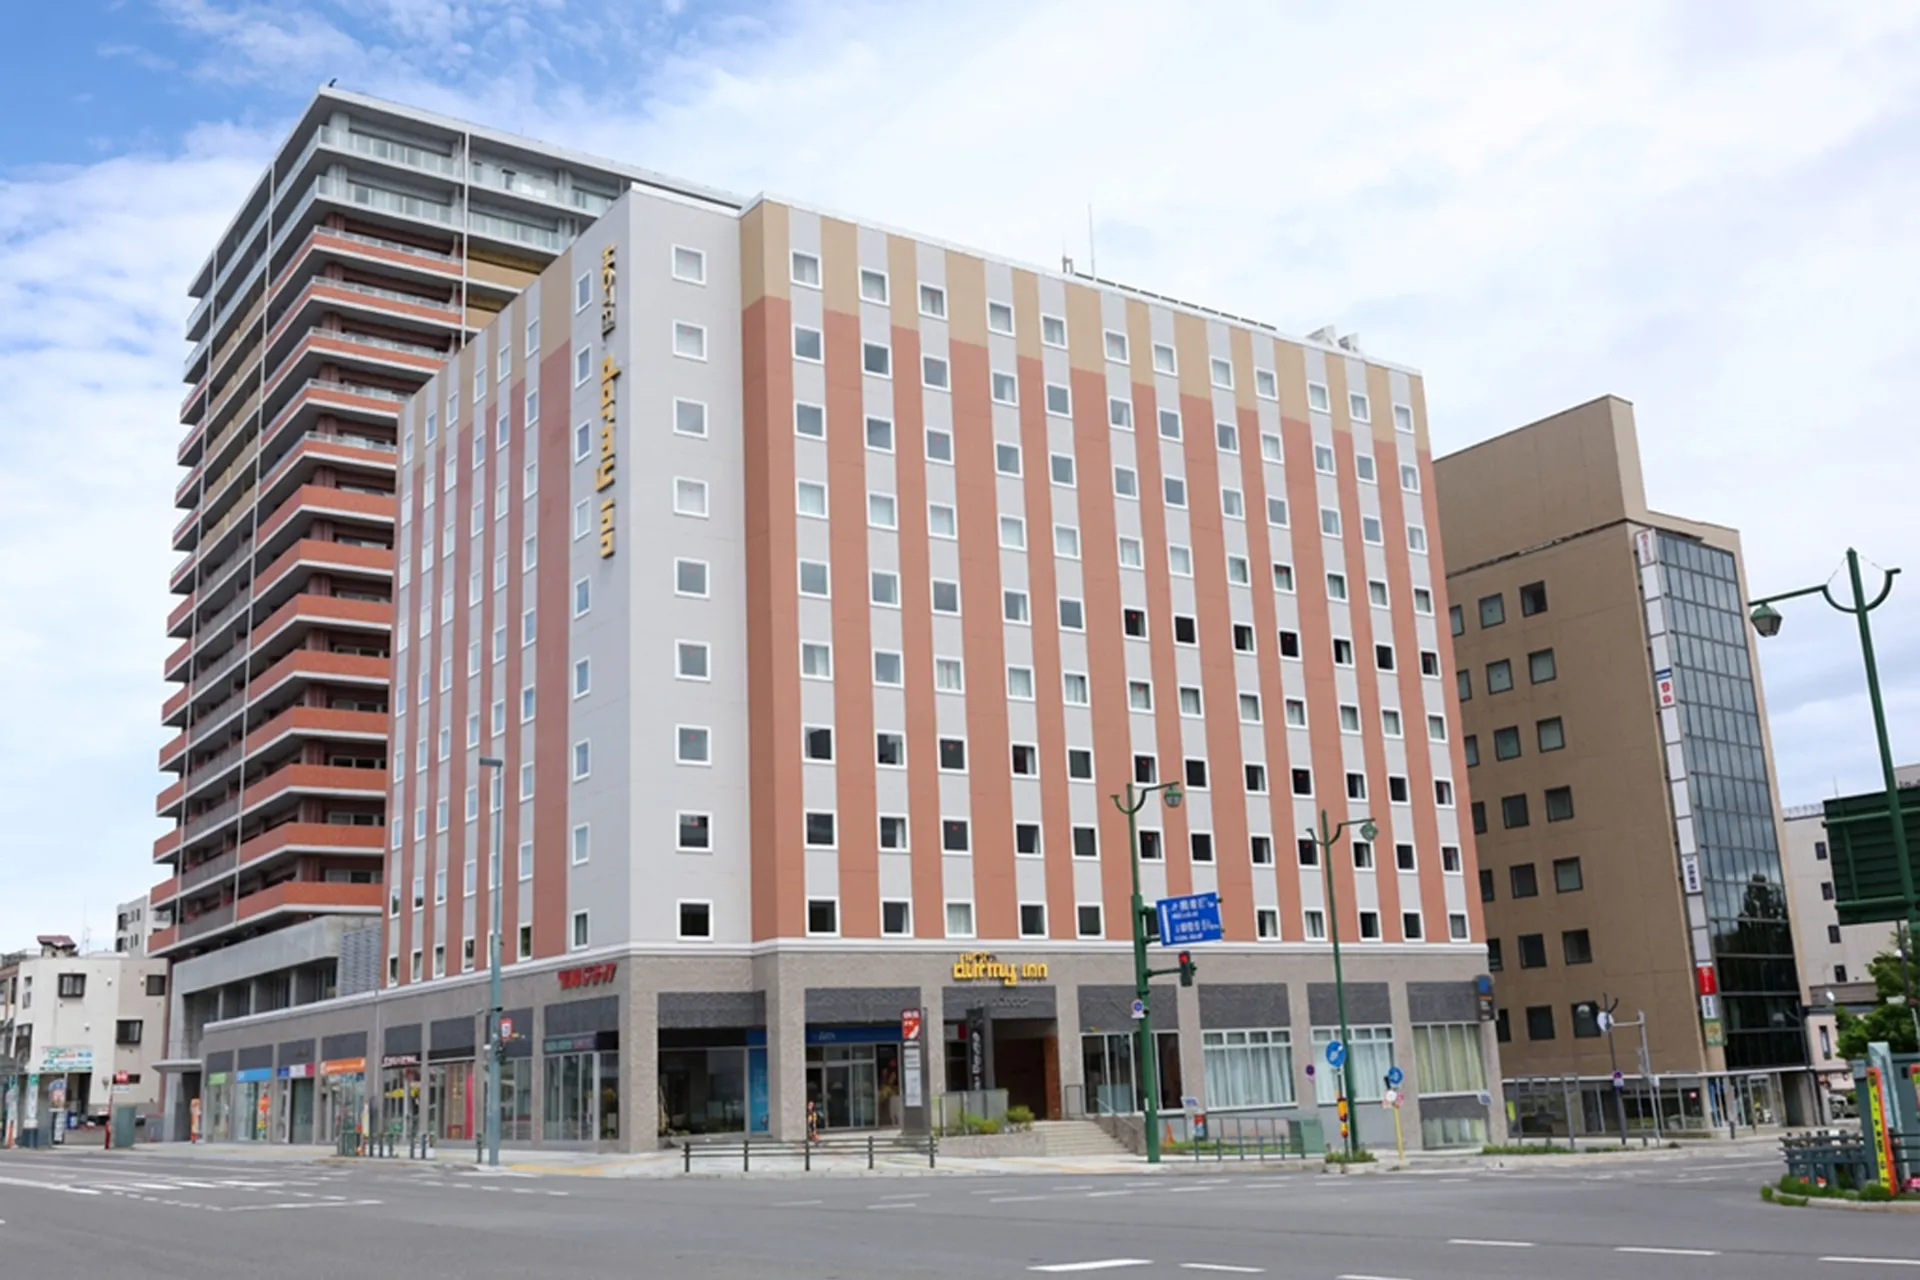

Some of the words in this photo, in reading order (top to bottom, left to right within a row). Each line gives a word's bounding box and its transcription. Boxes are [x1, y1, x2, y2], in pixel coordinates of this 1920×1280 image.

[595, 353, 621, 493] dormy
[600, 497, 616, 559] inn
[1022, 963, 1049, 980] inn
